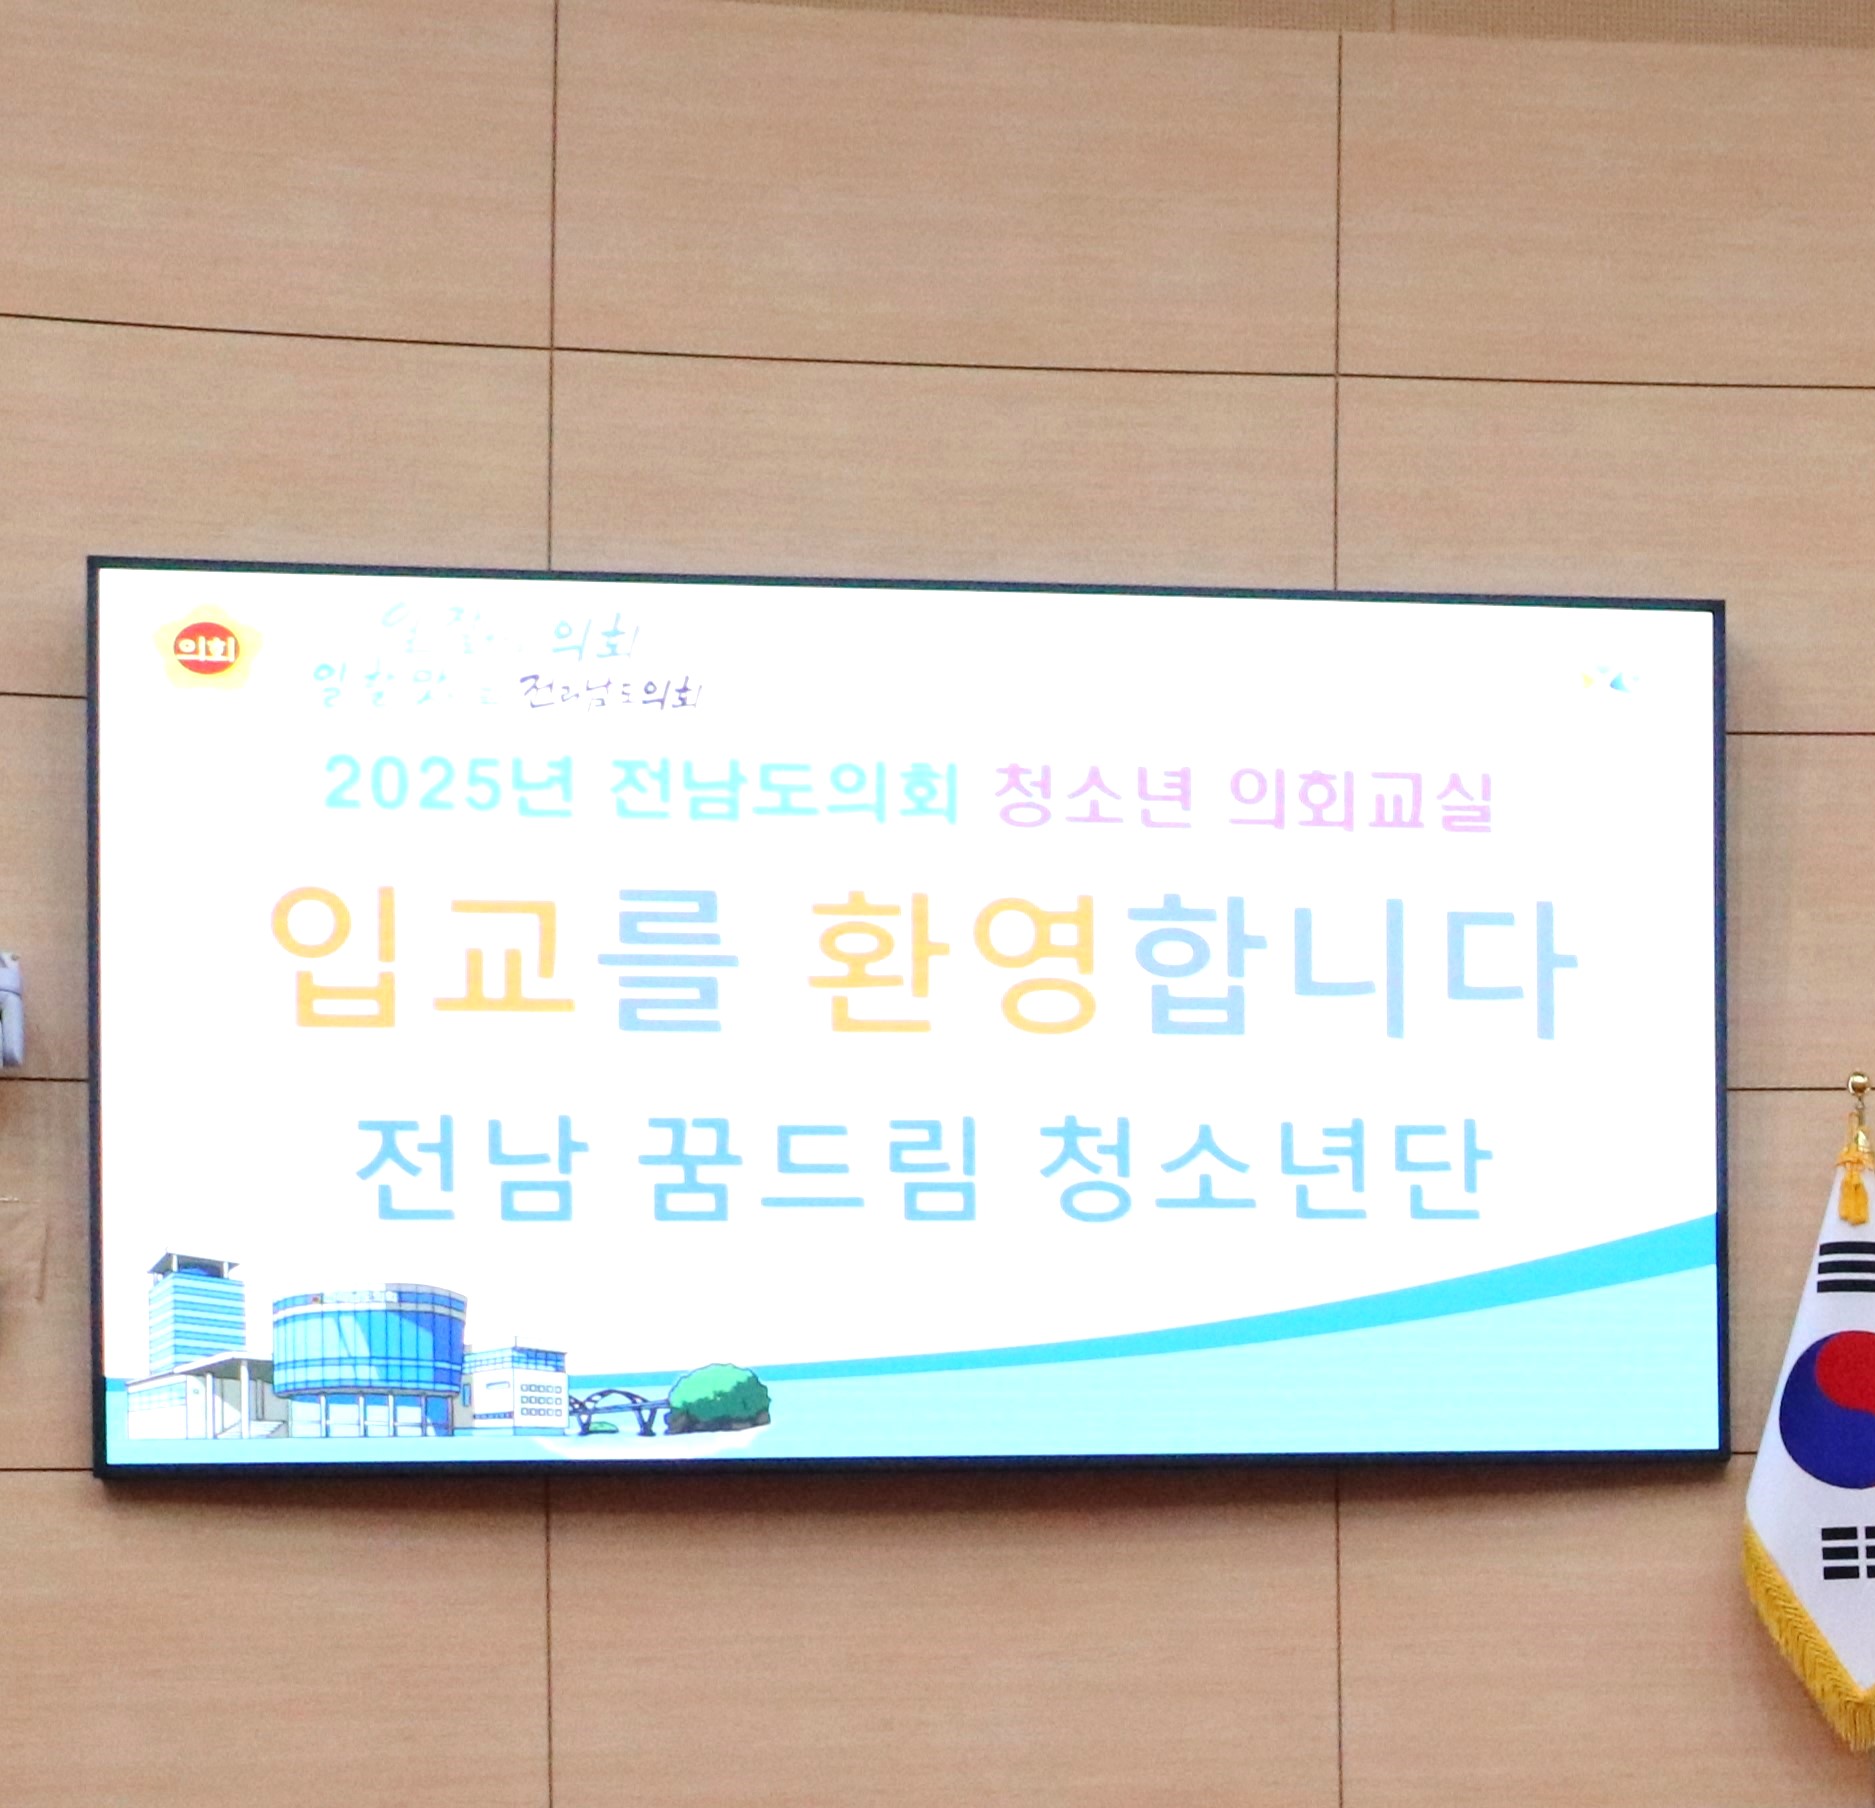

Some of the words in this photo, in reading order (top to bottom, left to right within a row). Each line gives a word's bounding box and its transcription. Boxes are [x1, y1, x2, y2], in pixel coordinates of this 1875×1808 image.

[177, 634, 237, 664] 의회
[552, 613, 638, 660] 의회
[520, 674, 702, 710] 전라남도의회
[325, 754, 572, 818] 2025년
[611, 758, 957, 824] 전남도의회
[995, 764, 1191, 828] 청소년
[1231, 768, 1491, 832] 의회교실
[273, 887, 738, 1032] 입교를
[810, 891, 1578, 1039] 환영합니다
[357, 1115, 588, 1221] 전남
[639, 1117, 976, 1221] 꿈드림
[1040, 1115, 1493, 1222] 청소년단
